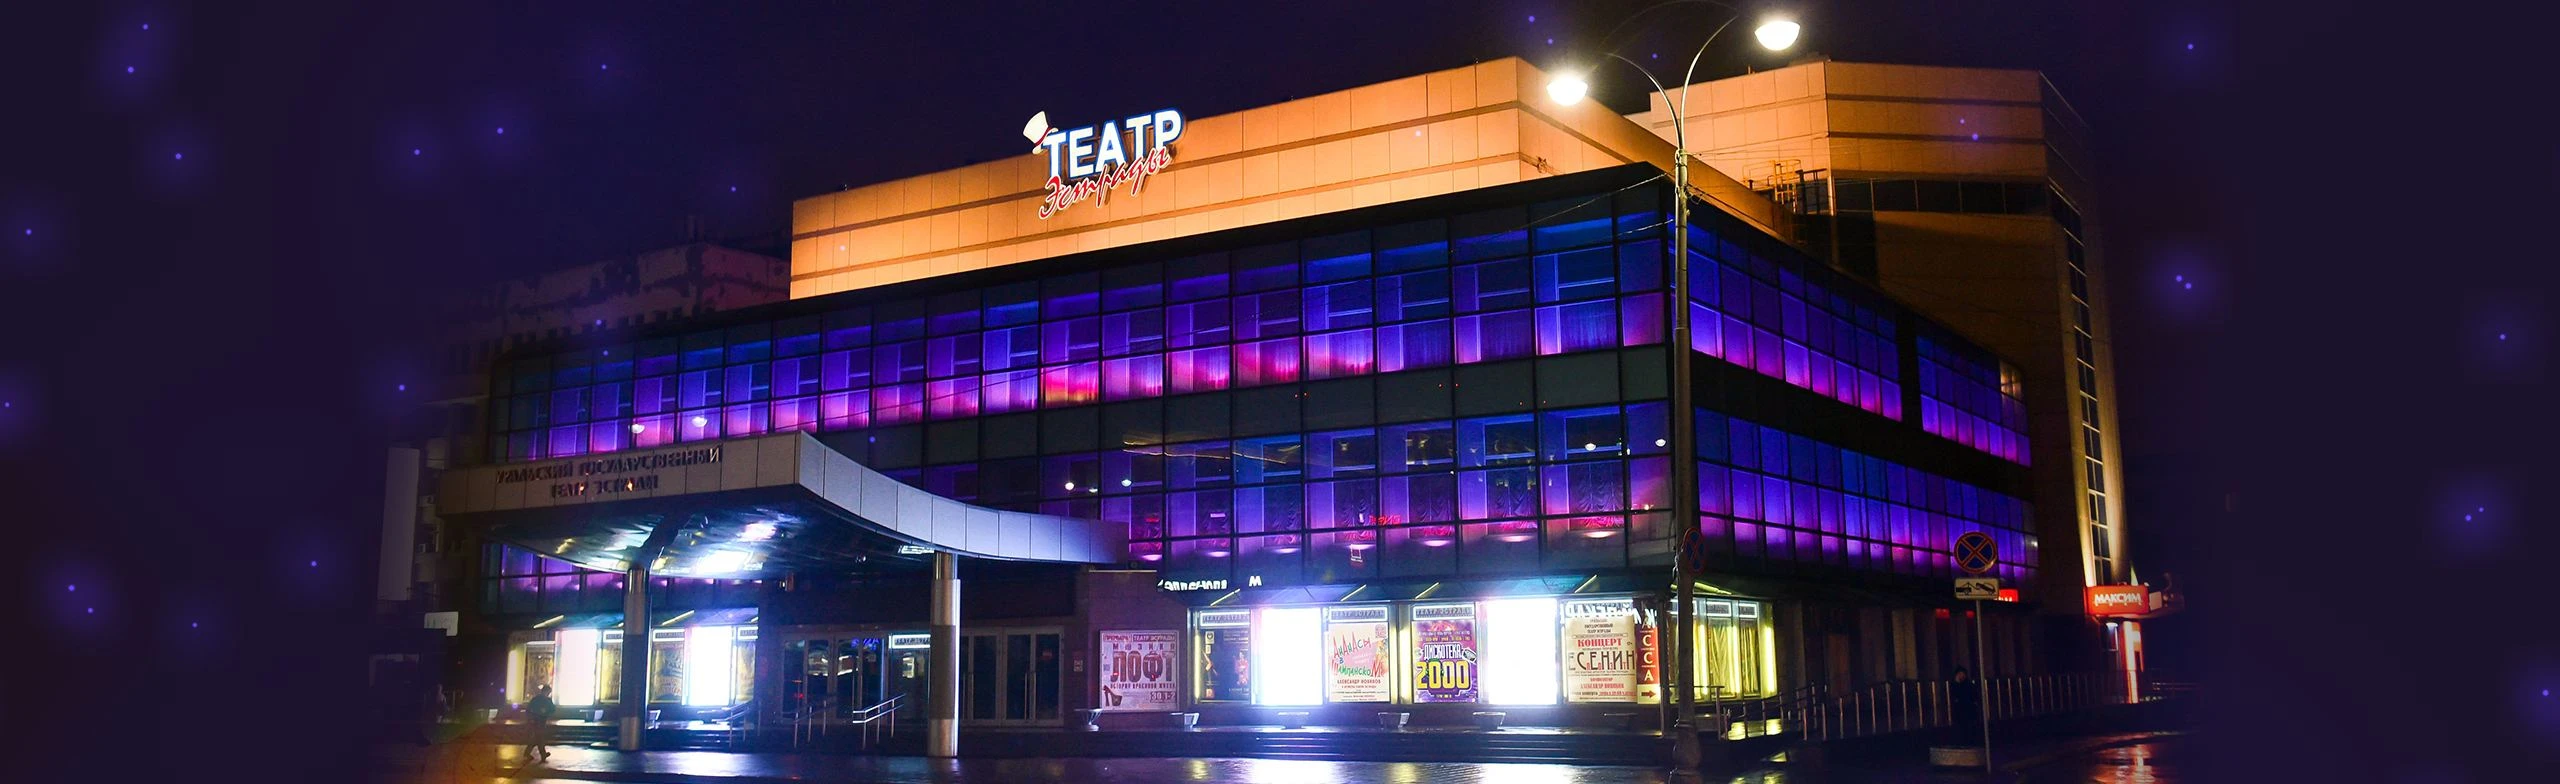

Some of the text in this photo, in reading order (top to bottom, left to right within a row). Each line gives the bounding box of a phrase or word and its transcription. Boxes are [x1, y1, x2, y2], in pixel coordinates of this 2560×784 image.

[1043, 108, 1184, 178] ТЕАТР
[1039, 147, 1172, 219] Эстрады
[2094, 593, 2142, 606] МАКСИМ
[1424, 644, 1462, 660] ДИСКОТЕКА
[1577, 638, 1622, 648] КОНЦЕРТ
[1111, 651, 1175, 682] ЛОФТ
[1416, 660, 1470, 689] 2000
